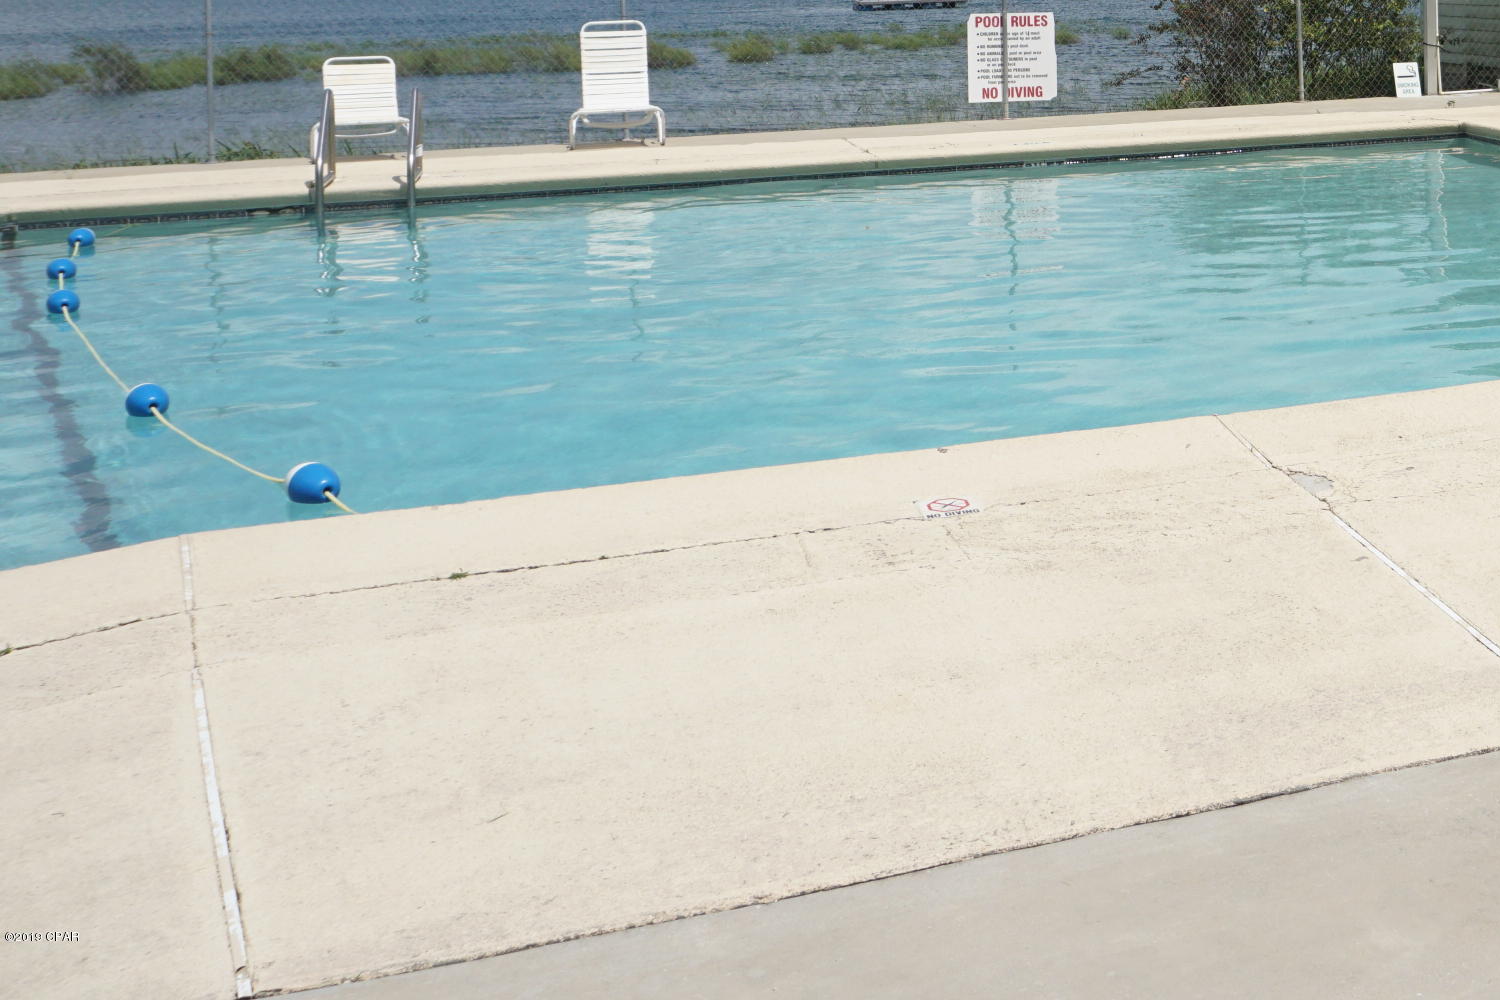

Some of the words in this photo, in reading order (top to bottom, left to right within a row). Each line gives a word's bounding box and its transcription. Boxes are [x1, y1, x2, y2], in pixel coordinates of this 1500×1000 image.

[1011, 15, 1048, 27] RULES
[982, 87, 998, 99] NO
[945, 508, 980, 517] DIVING
